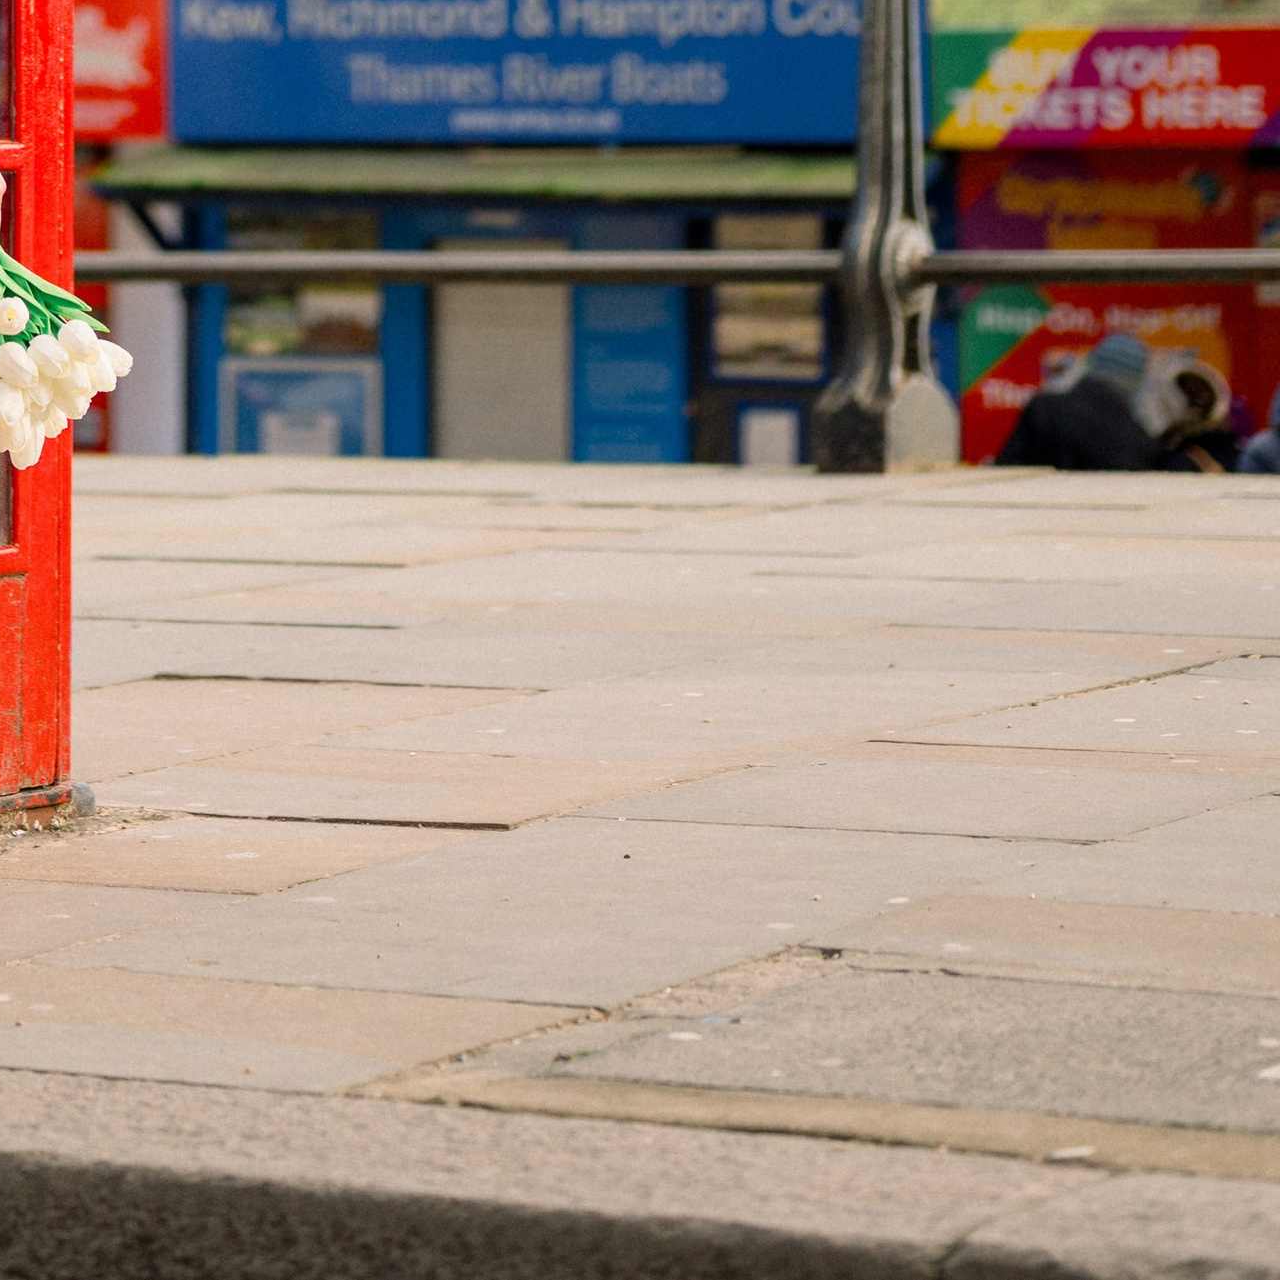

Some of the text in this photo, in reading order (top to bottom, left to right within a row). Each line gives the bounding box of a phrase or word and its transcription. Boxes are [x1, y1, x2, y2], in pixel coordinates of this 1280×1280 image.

[345, 51, 729, 105] Thames River Boats
[988, 44, 1221, 90] BUY YOUR
[947, 84, 1268, 130] TICKETS HERE
